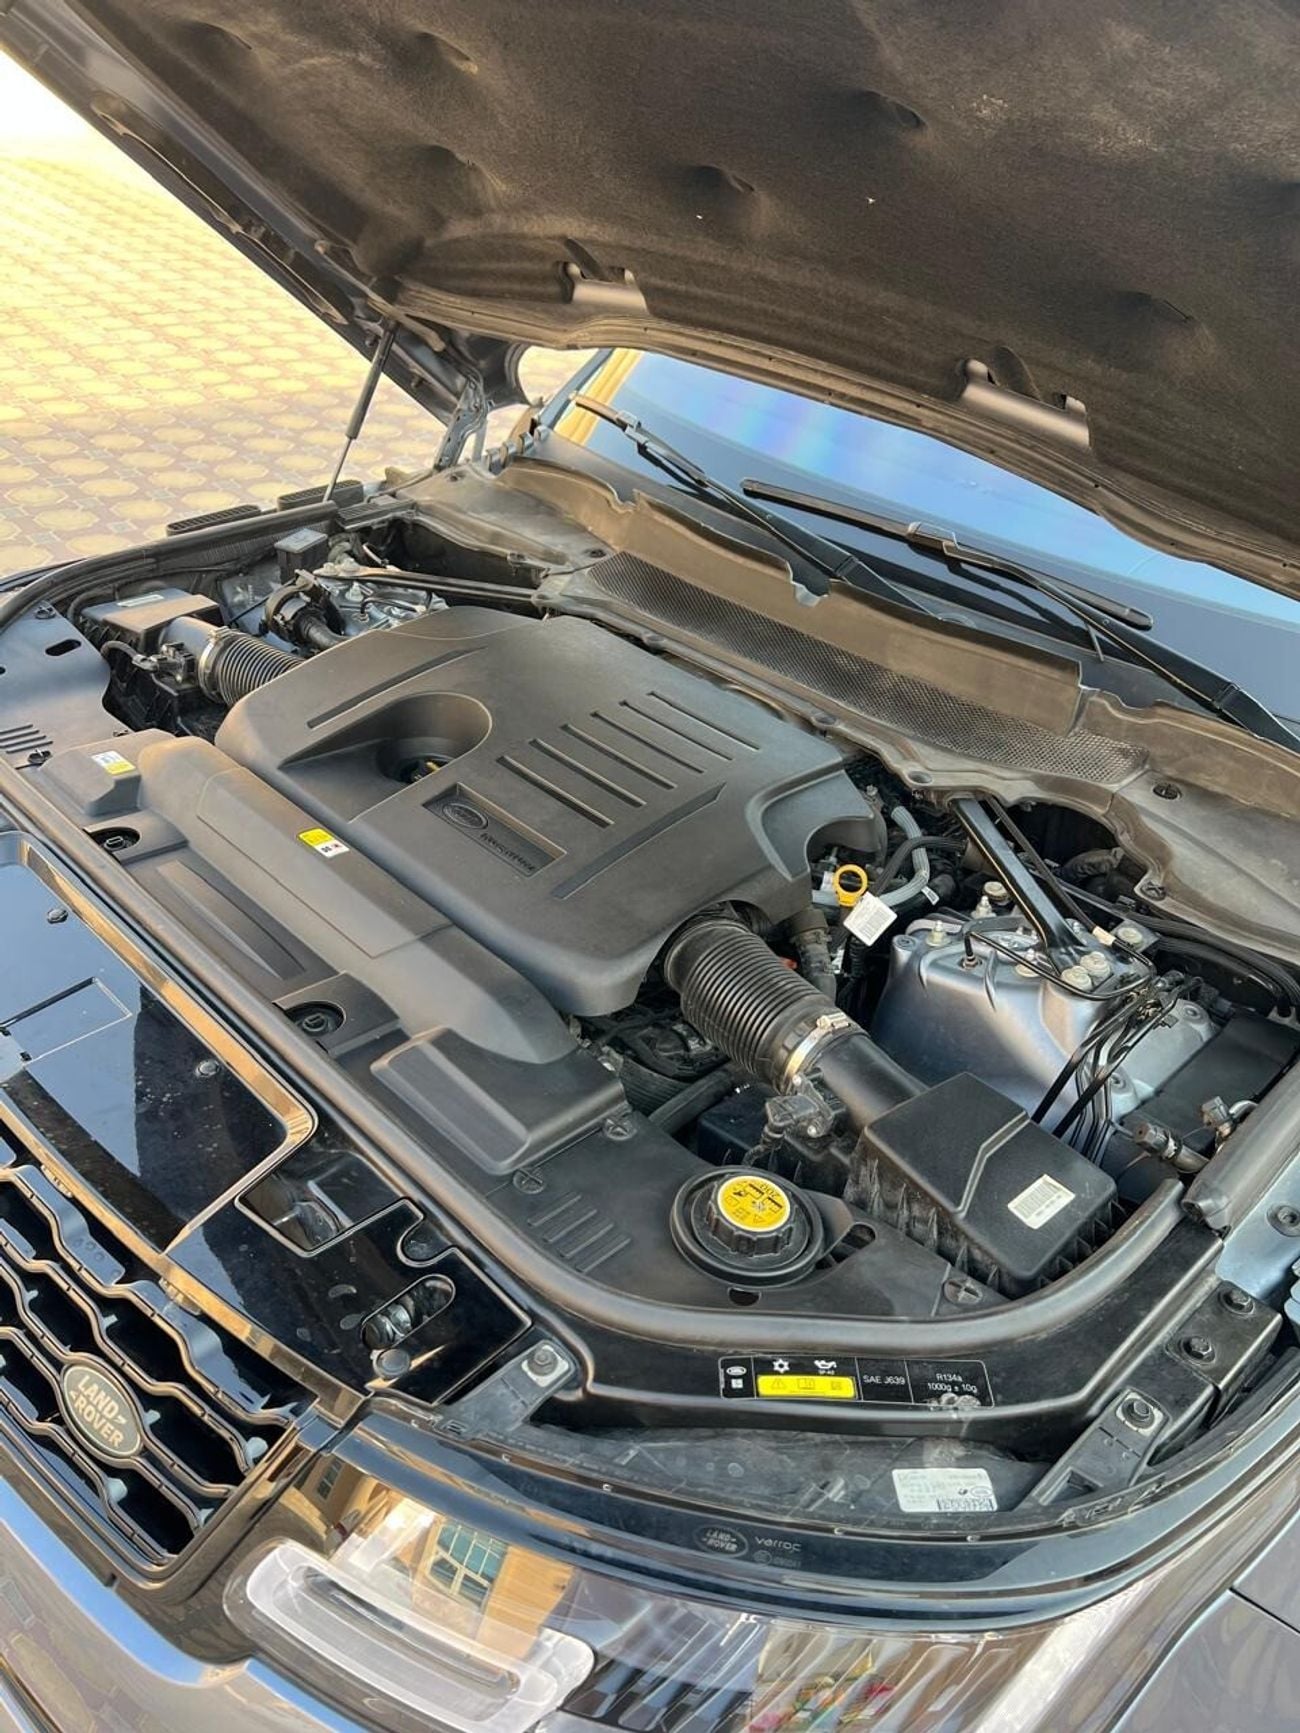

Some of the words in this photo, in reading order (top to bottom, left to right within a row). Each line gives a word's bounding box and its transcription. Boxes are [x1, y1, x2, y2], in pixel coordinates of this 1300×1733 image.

[863, 1375, 882, 1384] SAE
[884, 1376, 906, 1385] J639
[936, 1373, 963, 1382] R134a
[928, 1382, 952, 1392] 1000g
[962, 1384, 978, 1394] 10g
[78, 1375, 119, 1419] LAND
[75, 1396, 124, 1447] ROVER
[706, 1529, 732, 1541] LAND
[706, 1539, 738, 1552] ROVER
